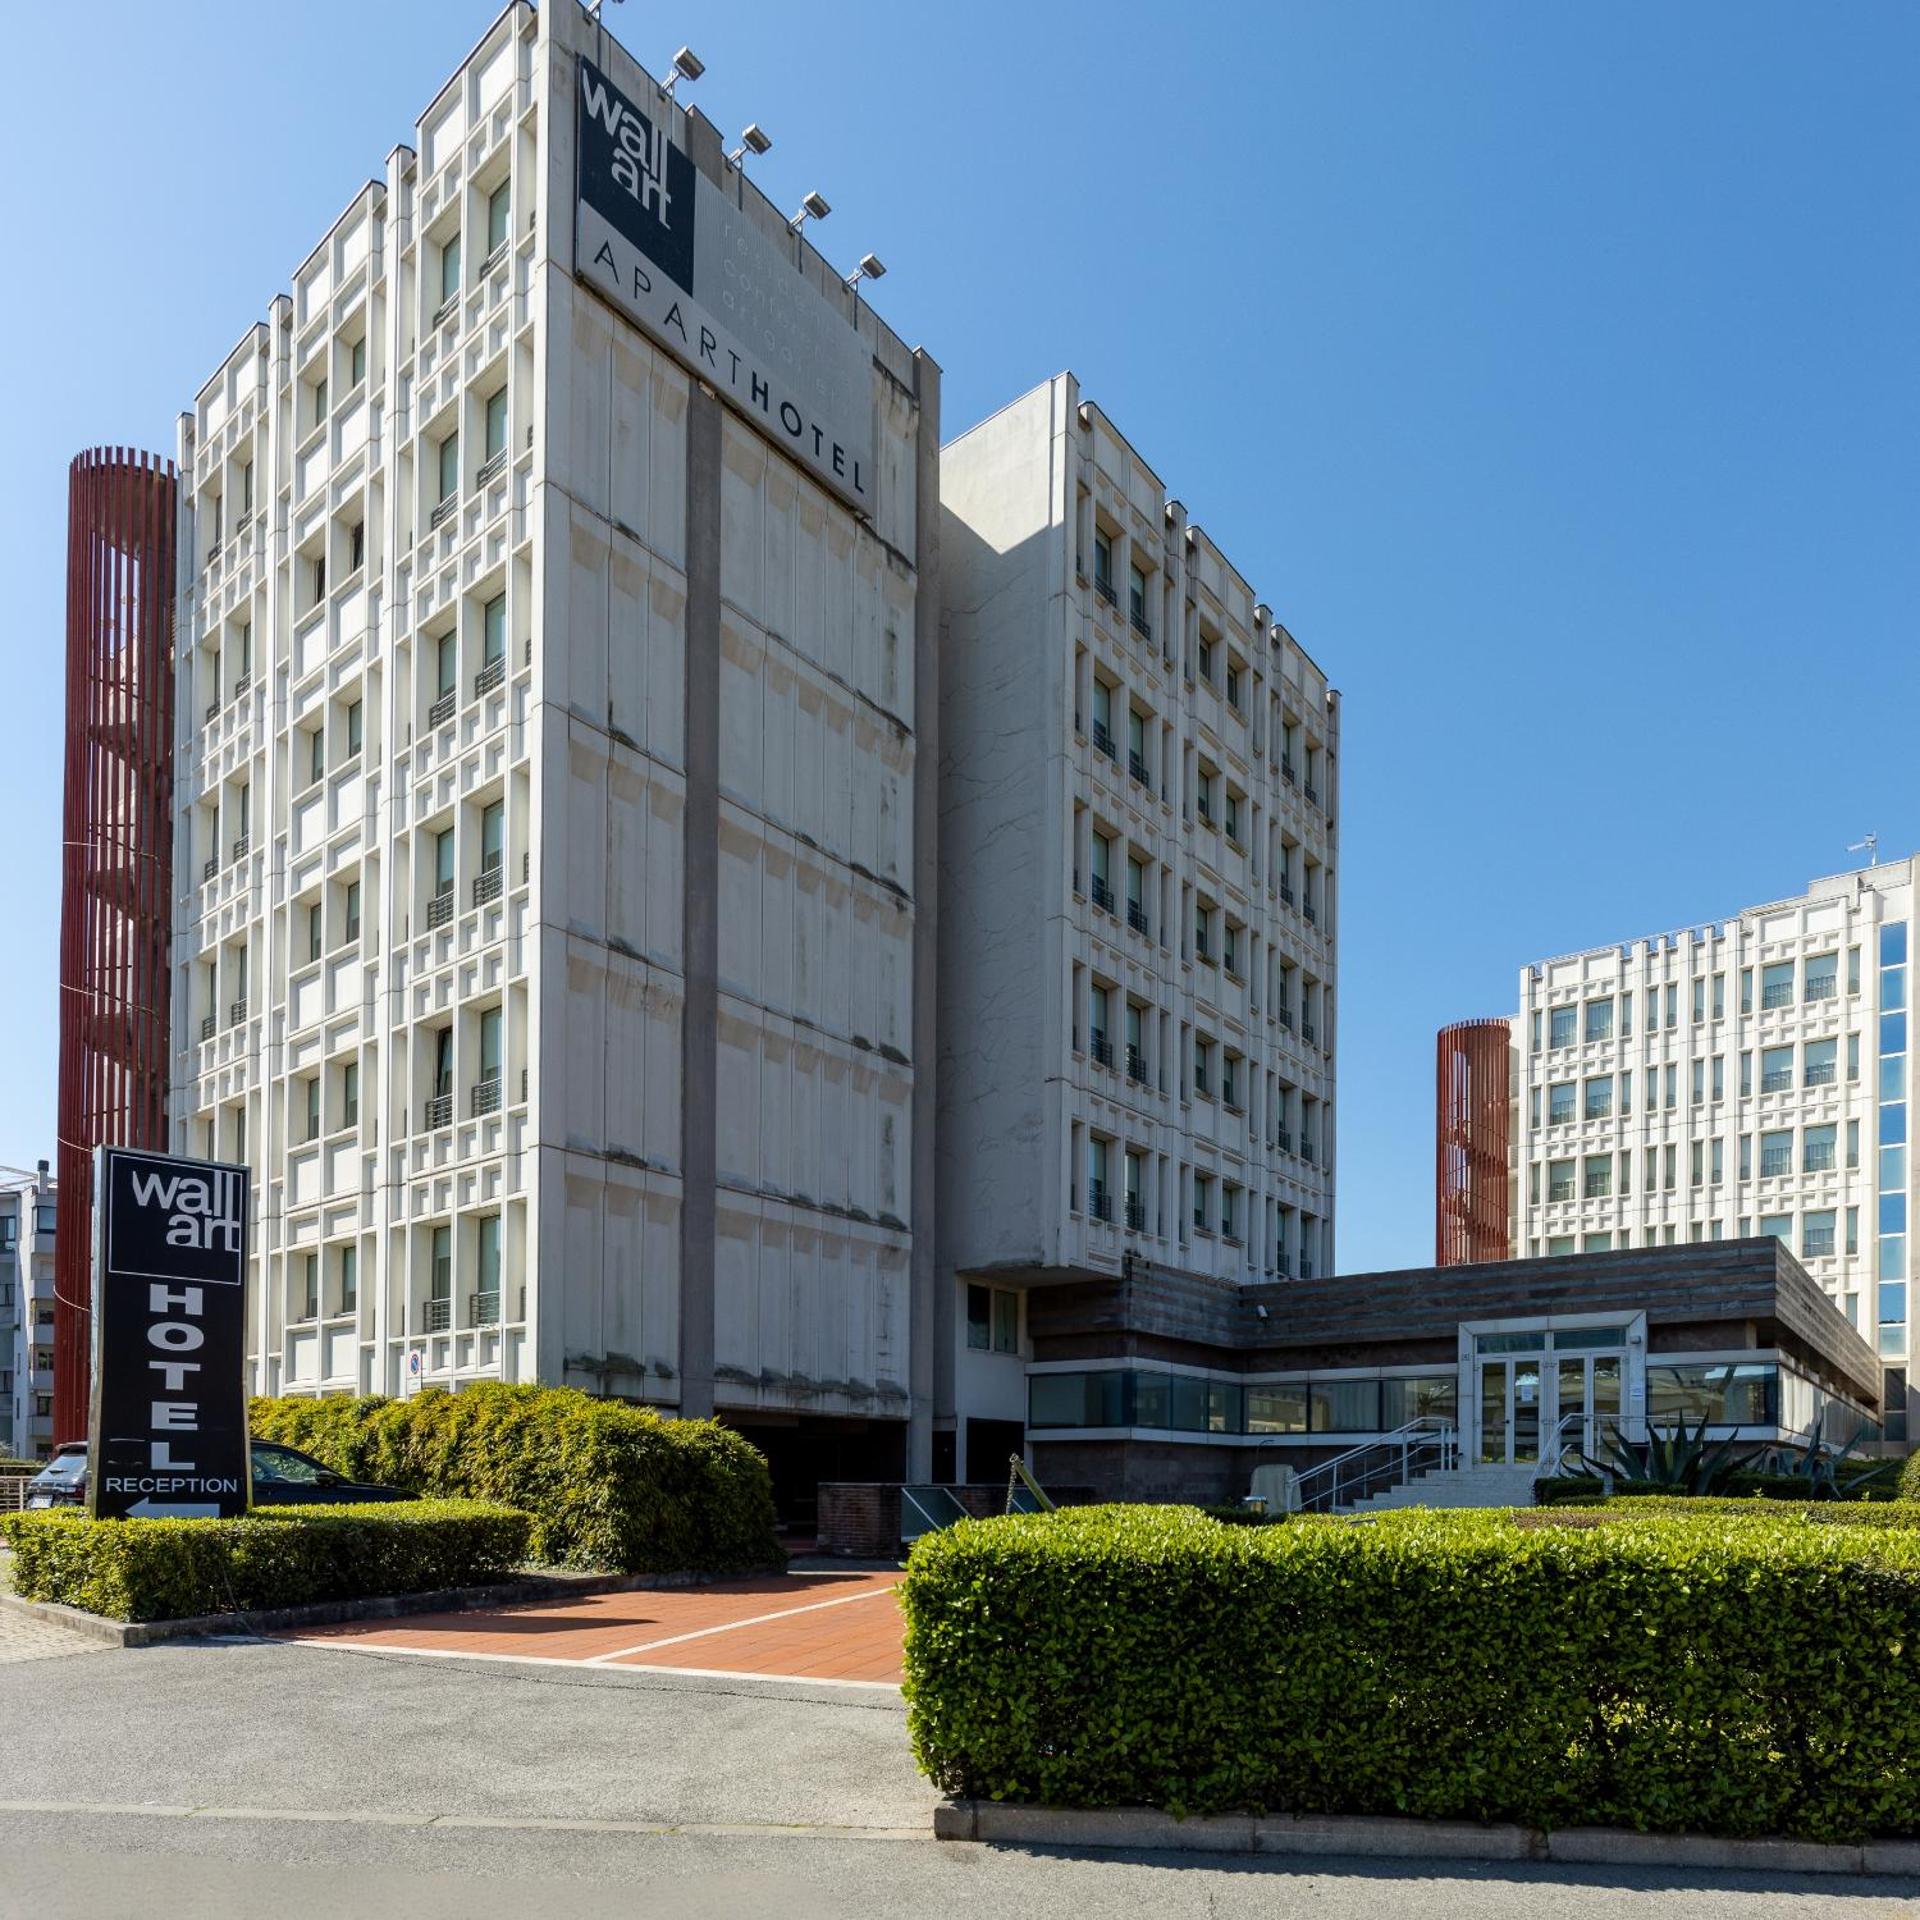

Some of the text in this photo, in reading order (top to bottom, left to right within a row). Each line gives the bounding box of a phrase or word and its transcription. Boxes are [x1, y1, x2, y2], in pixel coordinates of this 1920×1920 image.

[582, 68, 668, 180] wall
[611, 147, 671, 230] art
[594, 239, 865, 494] APARTHOTEL
[132, 1170, 234, 1219] wall
[166, 1214, 241, 1252] art
[147, 1283, 204, 1470] HOTEL
[105, 1477, 237, 1494] RECEPTION
